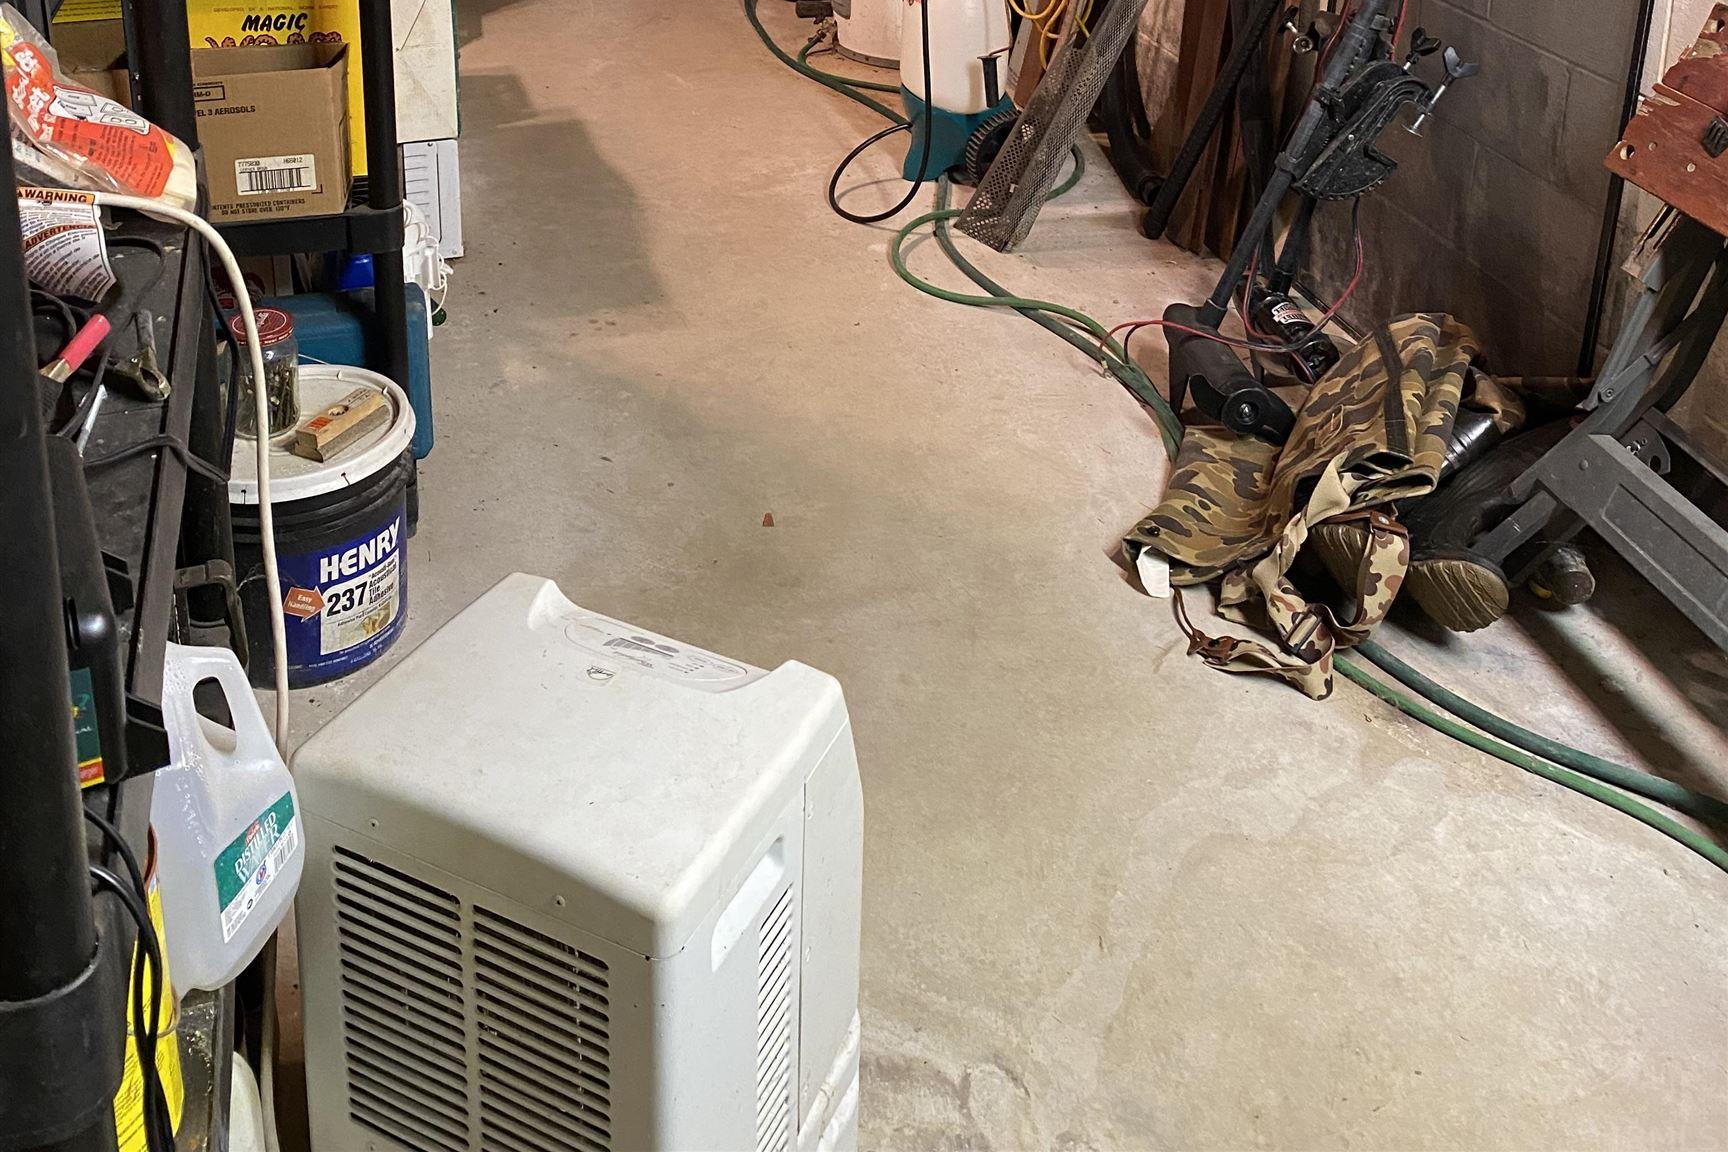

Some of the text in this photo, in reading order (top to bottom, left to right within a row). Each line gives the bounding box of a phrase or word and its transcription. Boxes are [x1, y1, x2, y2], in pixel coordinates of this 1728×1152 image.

[241, 12, 308, 33] MAGIC
[214, 105, 256, 116] AEROSOLS
[25, 188, 87, 203] WARNING
[320, 516, 400, 584] HENRY
[326, 580, 368, 617] 237
[368, 582, 394, 606] Adhesive
[369, 585, 381, 597] Tile
[234, 811, 277, 874] DISTILLED
